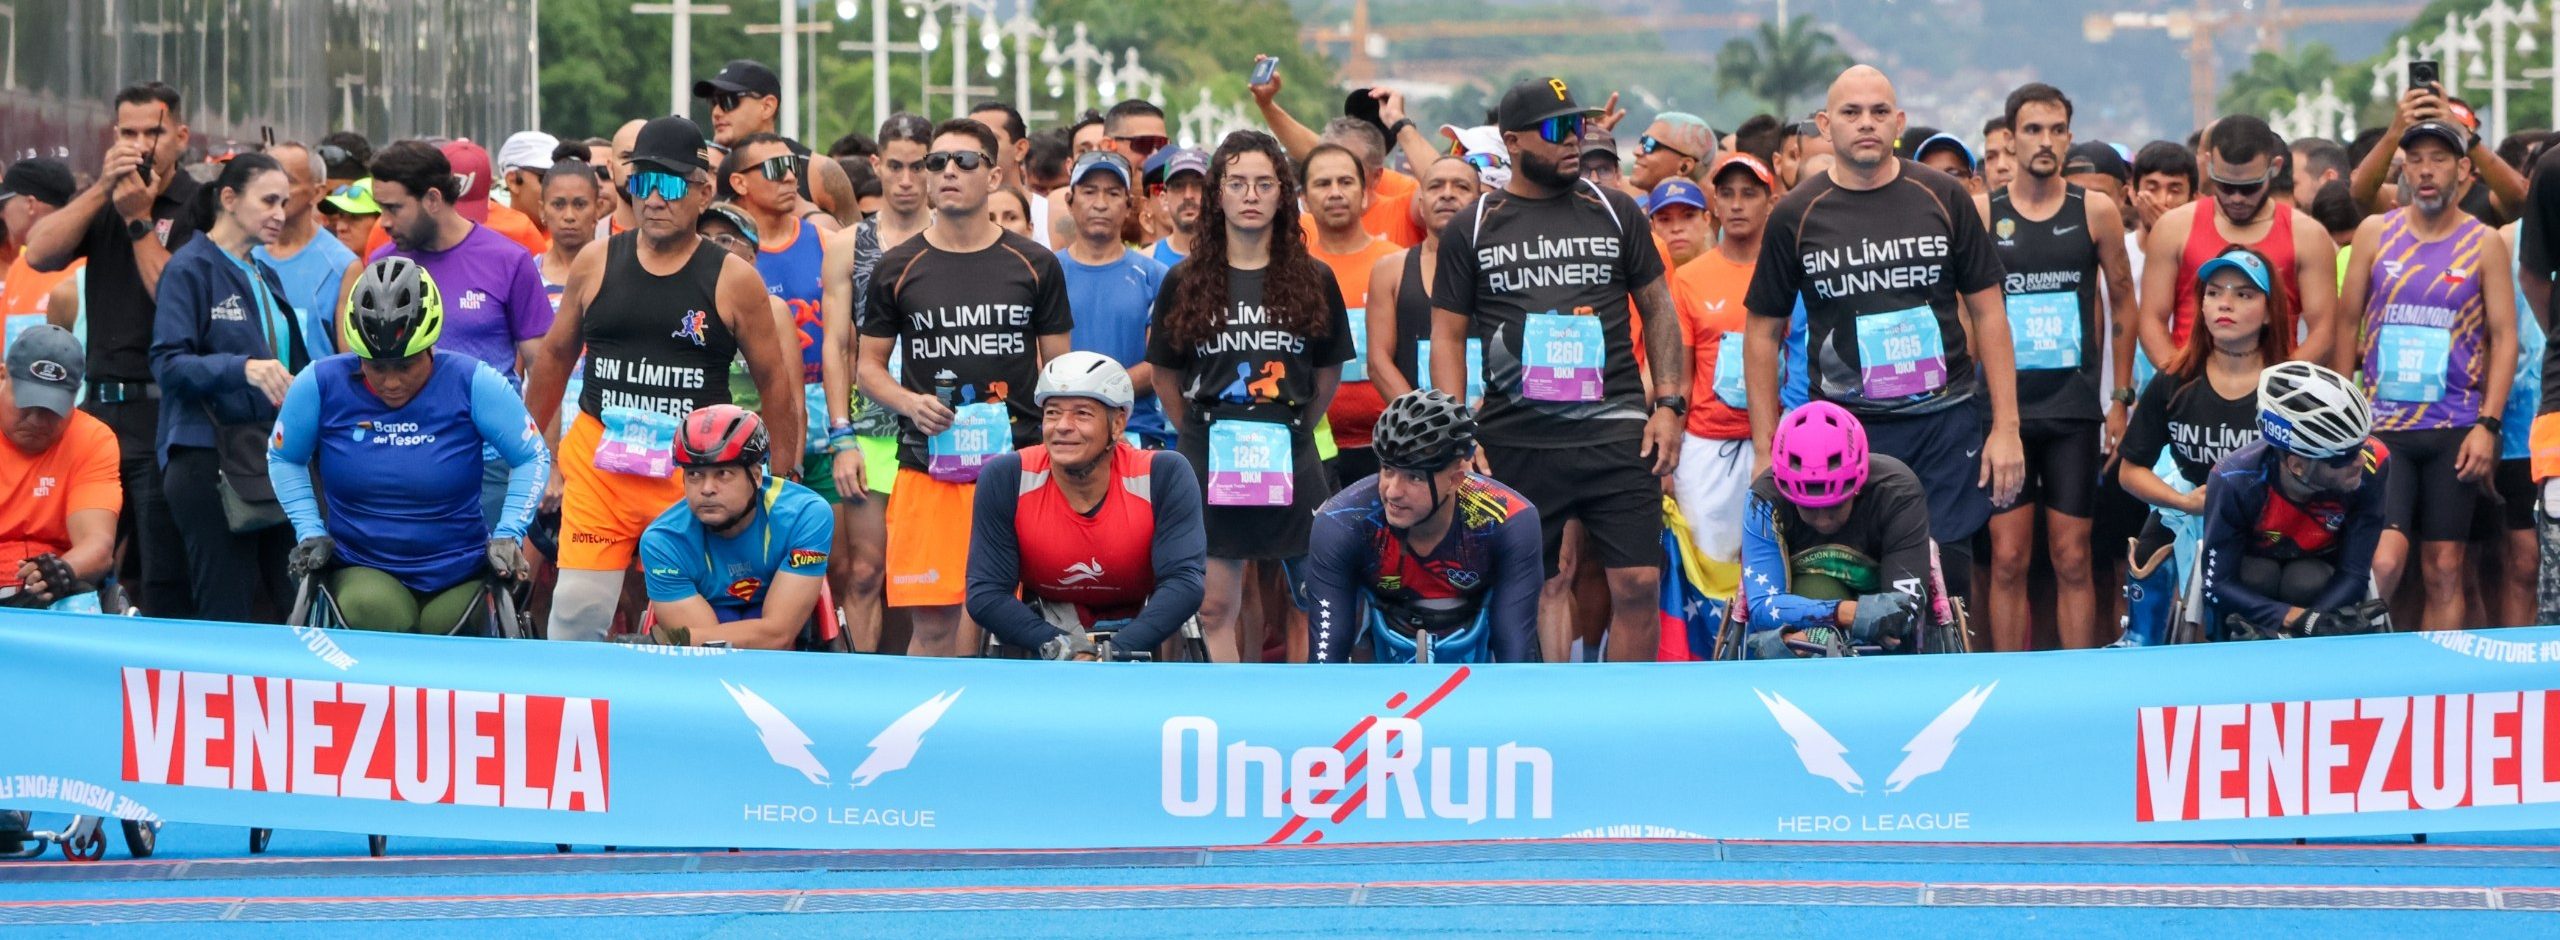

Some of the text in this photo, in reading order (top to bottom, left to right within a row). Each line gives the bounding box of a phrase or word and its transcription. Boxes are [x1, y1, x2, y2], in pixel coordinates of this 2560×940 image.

[1477, 234, 1620, 270] SIN LÍMITES
[1802, 235, 1949, 275] SIN LÍMITES
[1488, 263, 1613, 294] RUNNERS
[1814, 264, 1942, 300] RUNNERS
[2026, 270, 2082, 284] RUNNING
[459, 297, 481, 309] Run
[465, 290, 486, 302] One
[908, 309, 934, 331] IN
[911, 331, 1025, 360] RUNNERS
[1545, 340, 1583, 365] 1260
[594, 356, 704, 389] SIN LÍMITES
[373, 420, 419, 433] Banco
[2167, 421, 2200, 445] SIN
[373, 433, 435, 446] del Tesoro
[953, 428, 988, 451] 1261
[960, 454, 982, 466] 10KM
[1232, 445, 1271, 469] 1262
[1240, 470, 1262, 484] 10KM
[2474, 636, 2537, 664] FUTURE
[122, 667, 608, 813] VENEZUELA
[15, 774, 59, 800] #ONE
[60, 777, 116, 813] VISION
[743, 802, 936, 829] HERO LEAGUE
[1777, 811, 1971, 834] HERO LEAGUE
